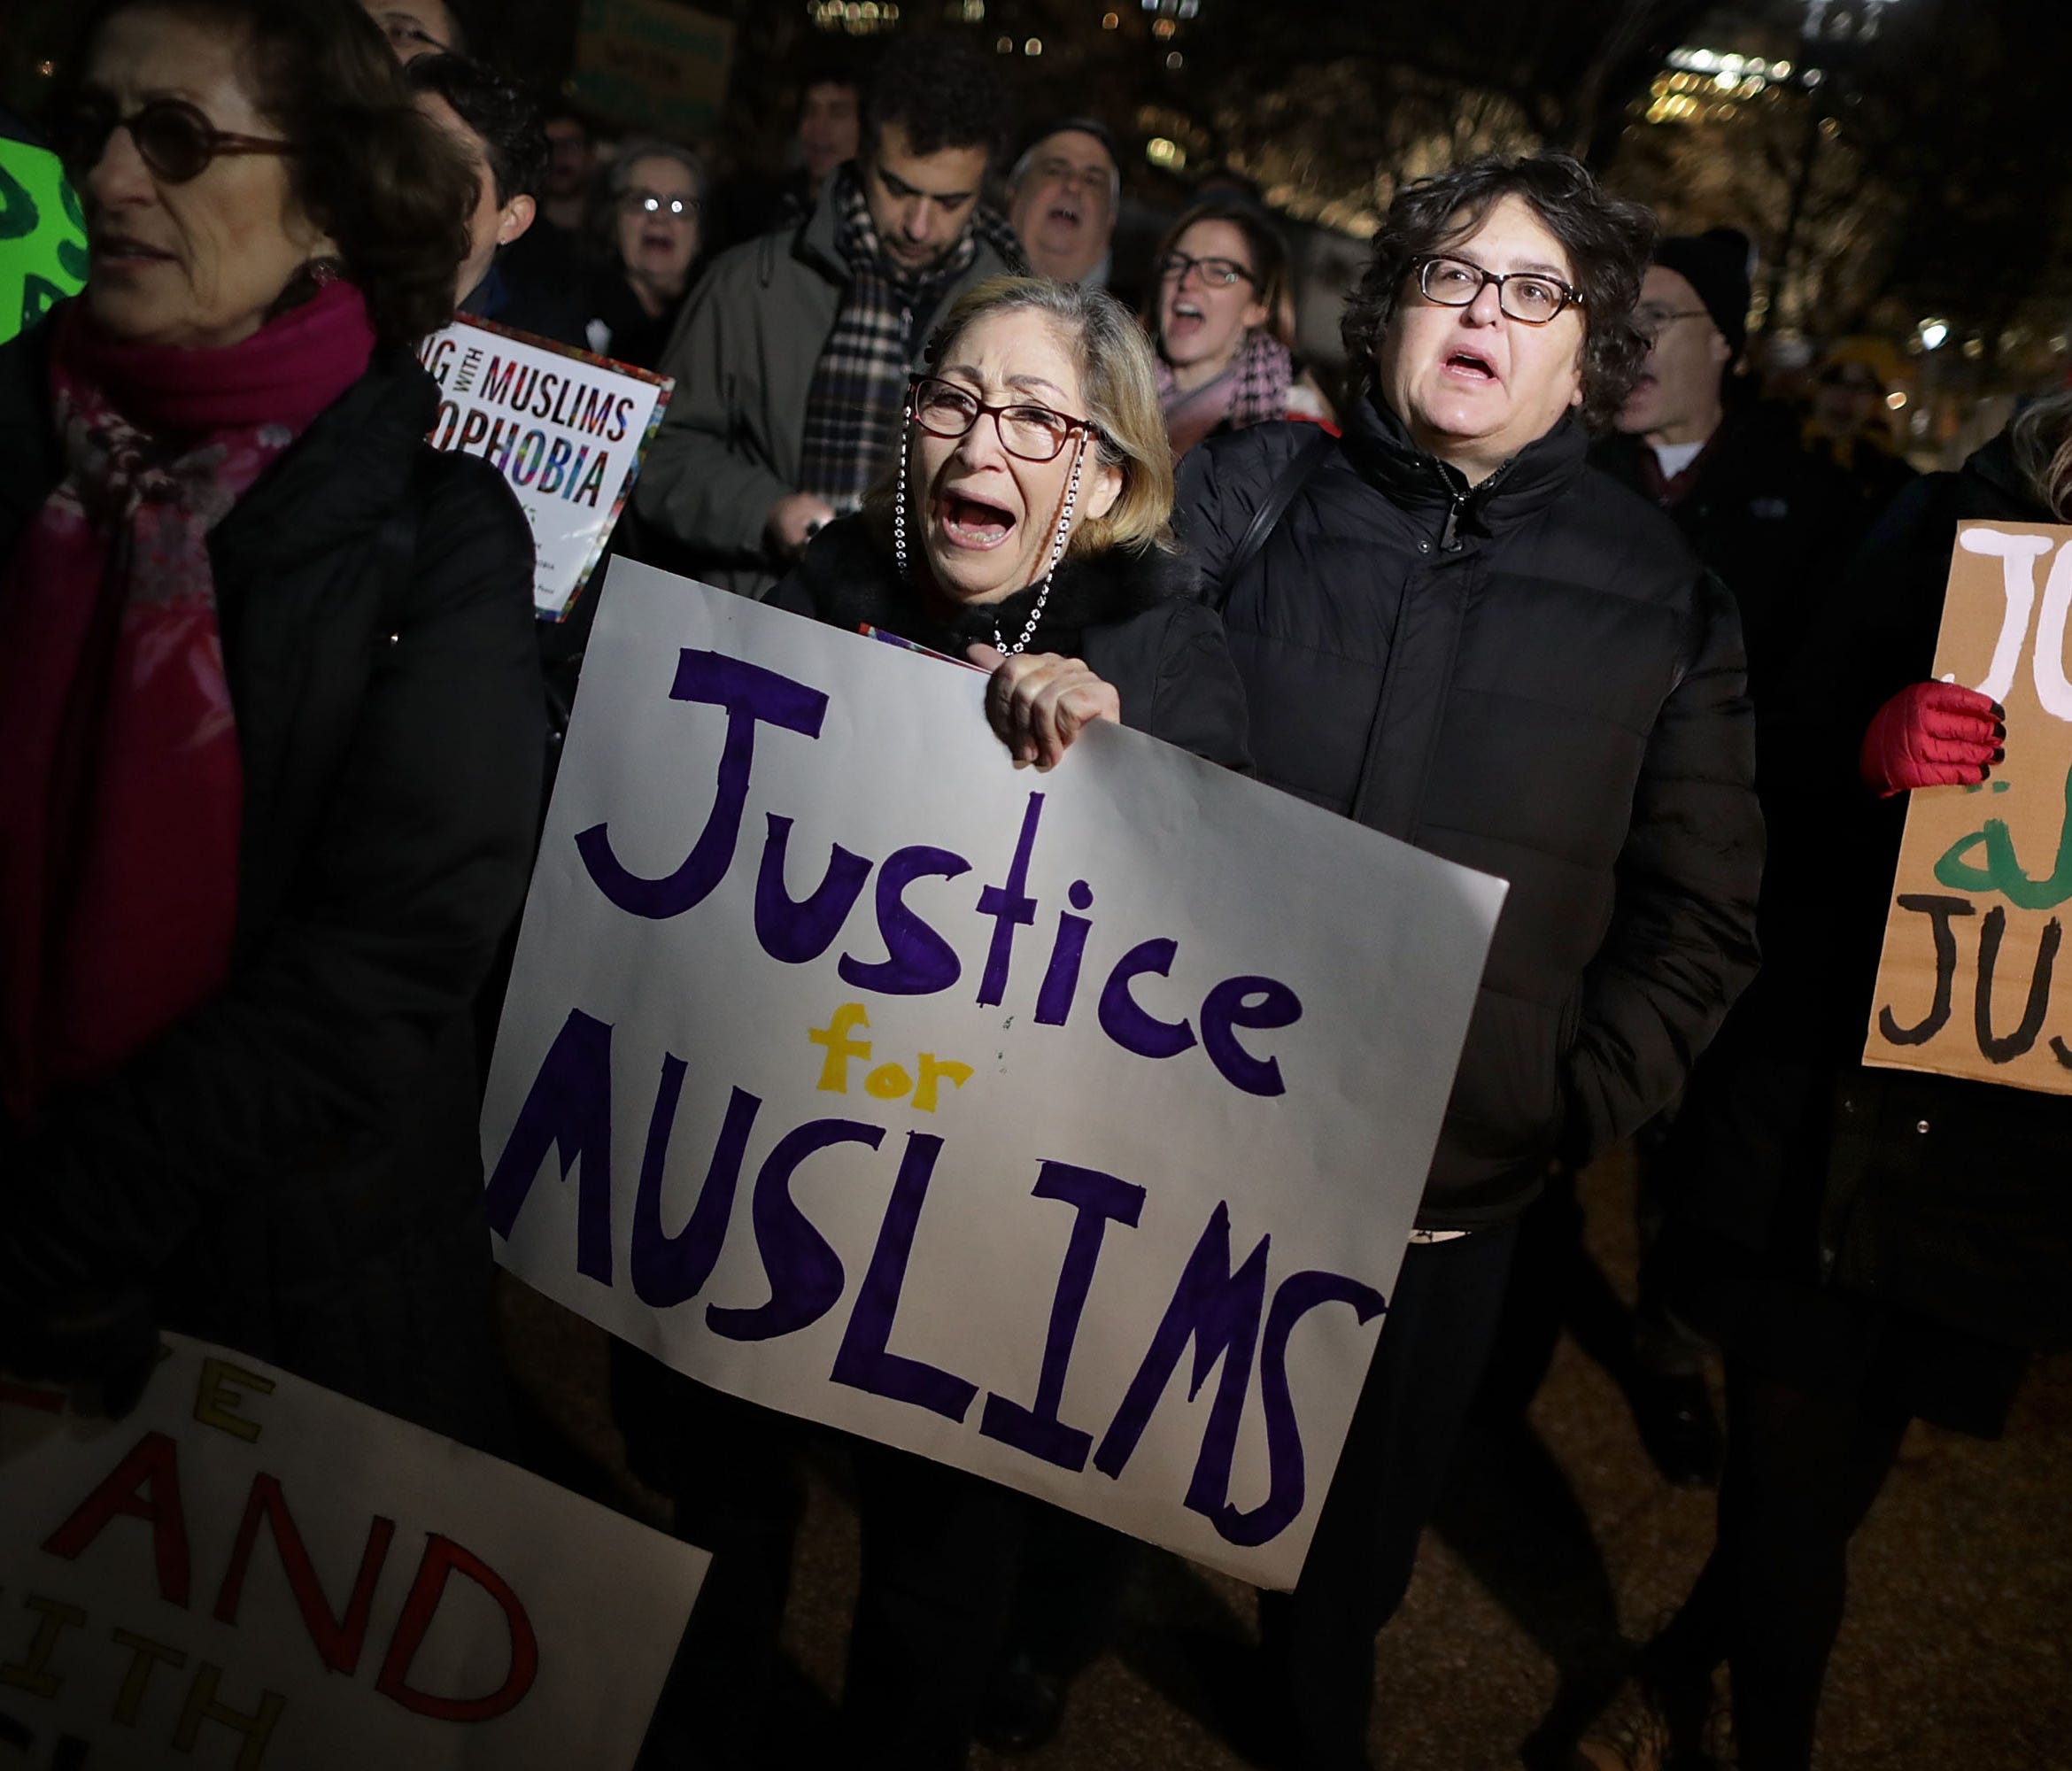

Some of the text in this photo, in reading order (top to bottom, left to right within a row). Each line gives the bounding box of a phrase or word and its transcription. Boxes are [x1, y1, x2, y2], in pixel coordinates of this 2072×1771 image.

[452, 347, 484, 392] WITH
[479, 356, 635, 442] MUSLIMS
[575, 648, 1302, 1096] Justice
[808, 1003, 974, 1113] for
[1879, 893, 2072, 1070] JU
[488, 1007, 1388, 1547] MUSLIMS
